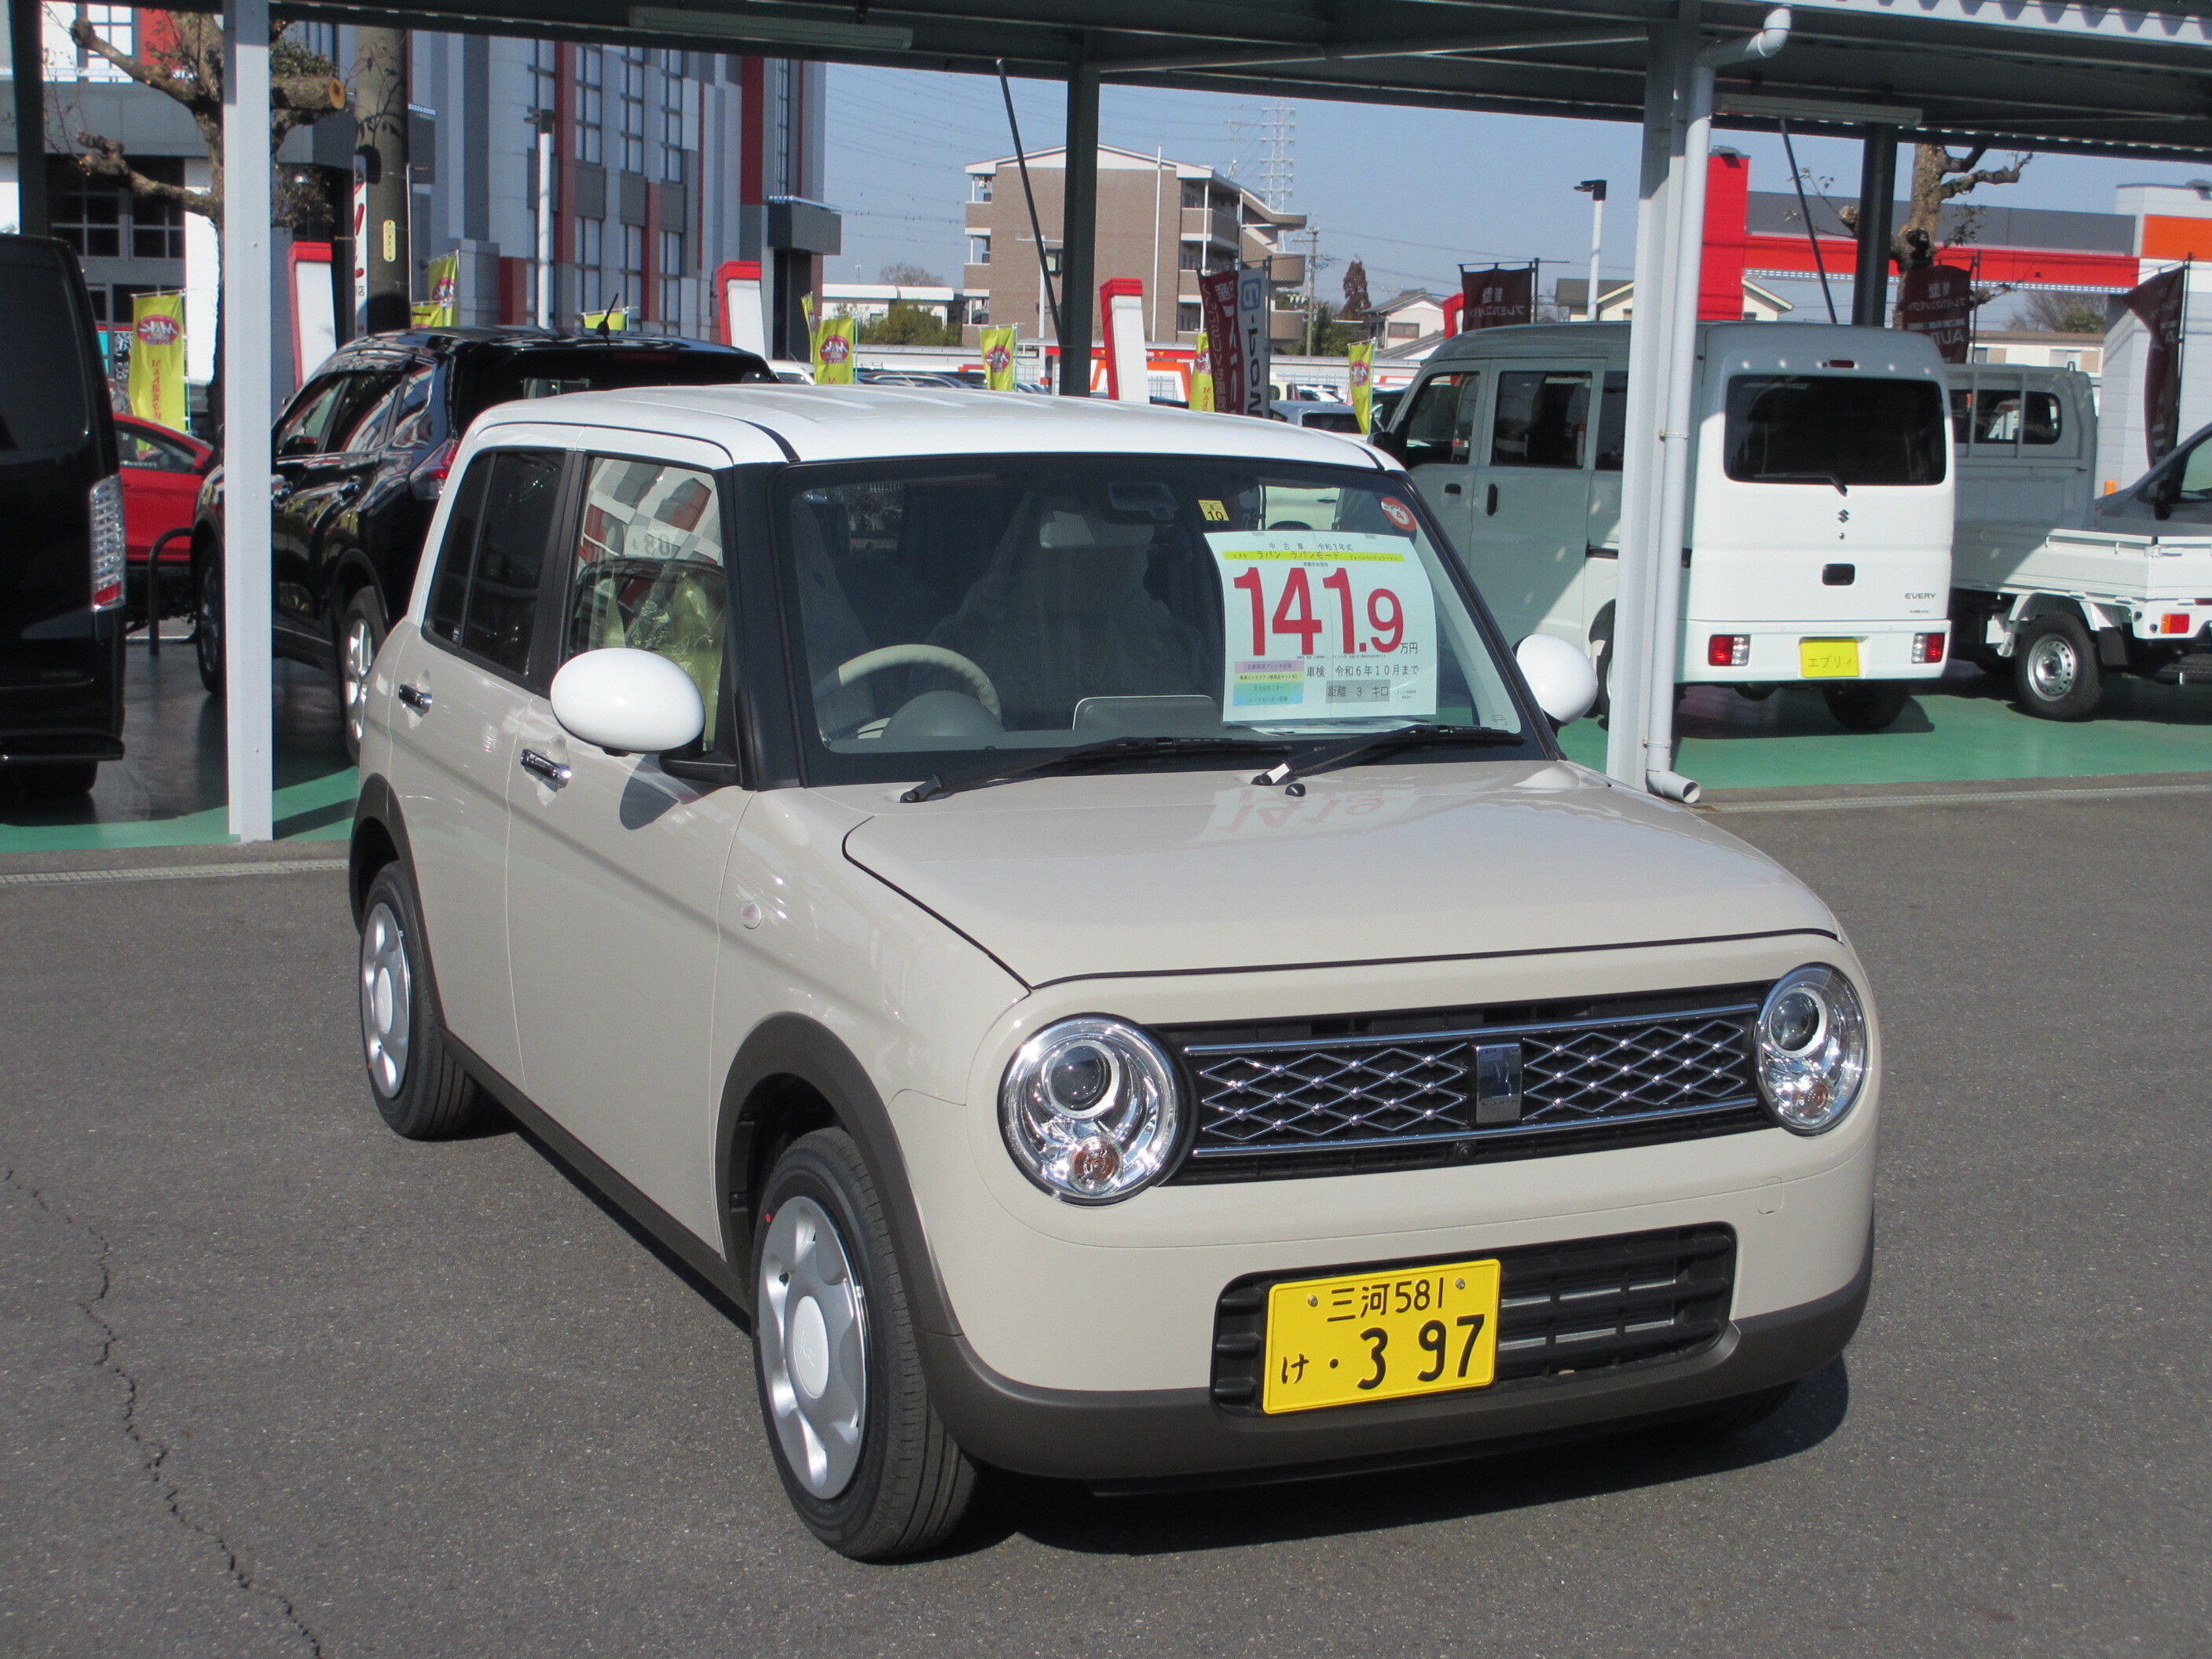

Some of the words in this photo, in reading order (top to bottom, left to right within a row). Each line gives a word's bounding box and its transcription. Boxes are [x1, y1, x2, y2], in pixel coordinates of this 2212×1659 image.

[1207, 511, 1224, 521] 10
[1317, 543, 1354, 551] 令和3年式
[1291, 551, 1340, 560] ラパンモード
[1233, 566, 1404, 657] 141.9
[1400, 642, 1419, 654] 万円
[1306, 665, 1326, 678] 車検
[1328, 685, 1346, 697] 距離
[1356, 687, 1363, 697] 3
[1372, 686, 1389, 697] キロ
[1280, 1353, 1309, 1384] け
